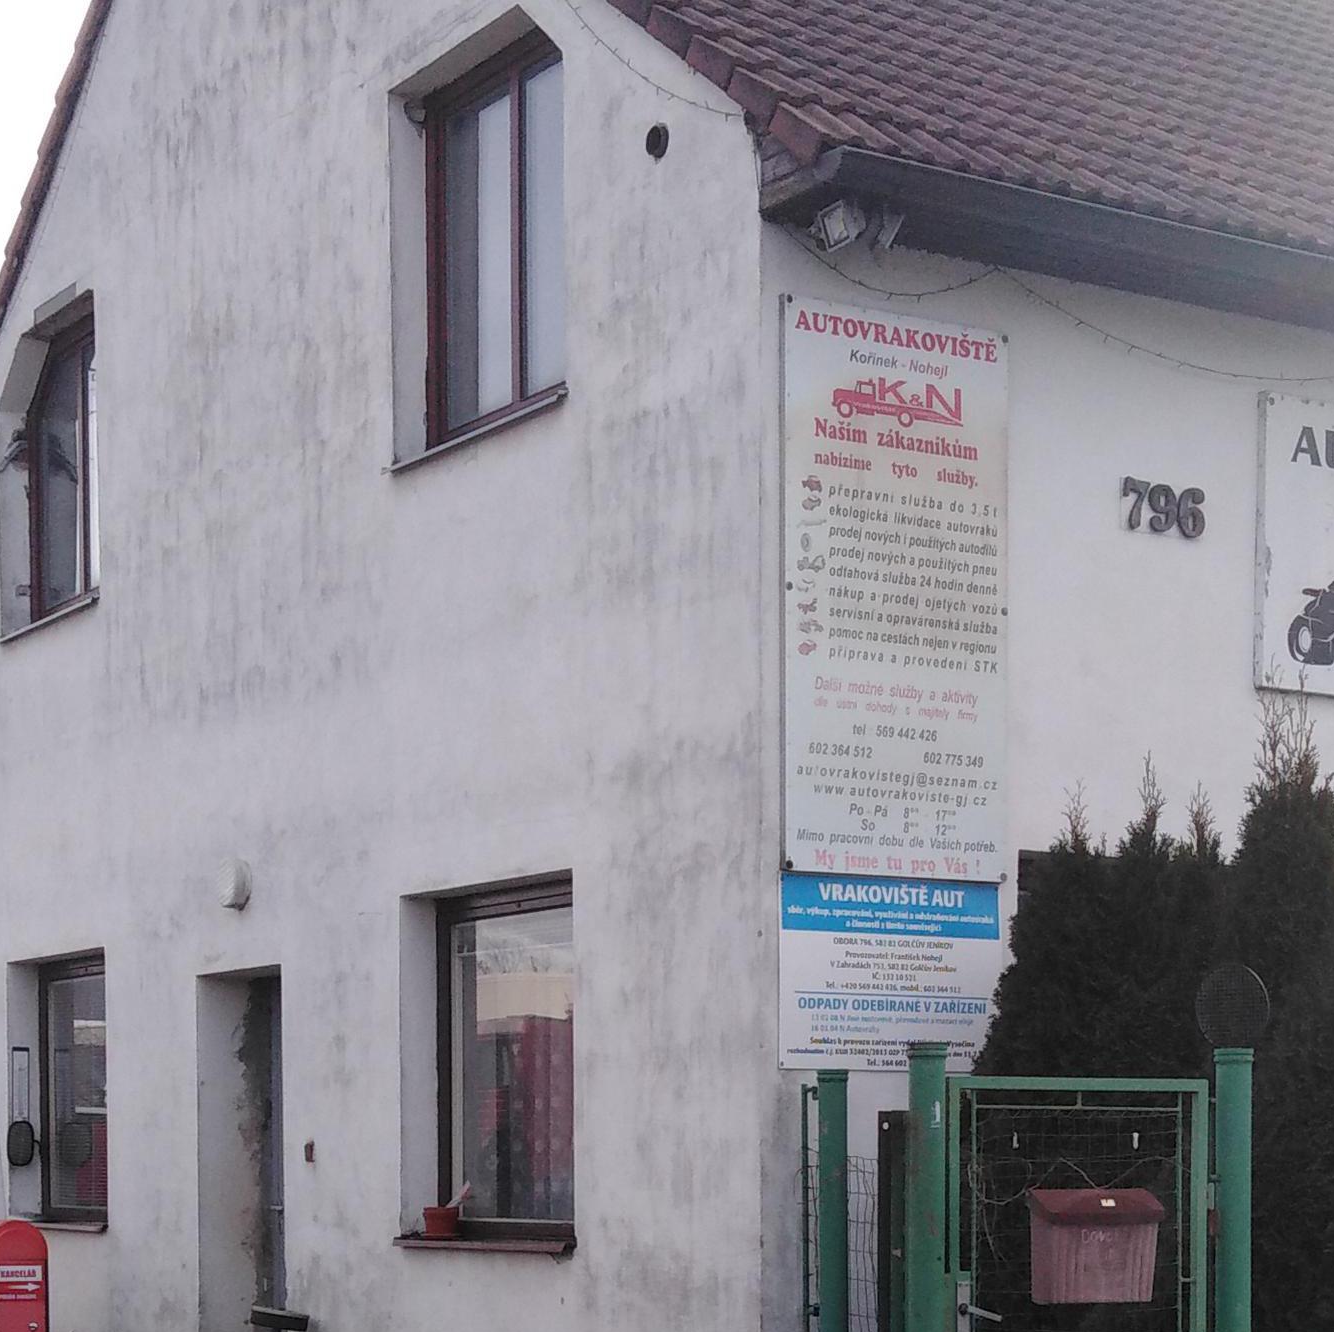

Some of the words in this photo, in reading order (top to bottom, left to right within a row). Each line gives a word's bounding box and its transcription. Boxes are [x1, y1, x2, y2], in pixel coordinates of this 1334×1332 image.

[795, 310, 998, 363] AUTOVRAKOVIŠTĚ
[909, 360, 948, 379] Nohejl
[892, 461, 917, 479] tyto
[901, 494, 943, 510] služba
[950, 499, 964, 513] do
[1123, 476, 1205, 538] 796
[894, 512, 941, 529] likvidace
[829, 526, 862, 542] prodej
[865, 530, 900, 547] nových
[909, 536, 956, 555] použitých
[829, 545, 865, 562] prodej
[868, 550, 906, 568] nových
[909, 555, 915, 566] a
[918, 557, 969, 577] použitých
[972, 565, 997, 577] pneu
[829, 566, 879, 581] odtahová
[882, 572, 916, 586] služba
[920, 575, 931, 587] 24
[935, 578, 964, 591] hodin
[829, 586, 864, 602] nákup
[870, 592, 876, 601] a
[882, 590, 919, 604] prodej
[925, 597, 966, 616] ojetých
[829, 607, 874, 621] servisní
[877, 611, 883, 622] a
[963, 621, 997, 635] služba
[829, 627, 863, 640] pomoc
[866, 630, 878, 642] na
[881, 631, 919, 646] cestách
[922, 638, 949, 651] nejen
[951, 641, 957, 650] v
[960, 641, 997, 656] regionu
[891, 653, 896, 663] a
[974, 660, 998, 673] STK
[890, 684, 923, 700] služby
[930, 690, 936, 700] a
[898, 727, 916, 740] 442
[919, 729, 937, 742] 426
[809, 742, 828, 755] 602
[831, 744, 850, 757] 364
[854, 745, 872, 759] 512
[923, 752, 942, 764] 602
[945, 753, 963, 766] 775
[965, 754, 984, 768] 349
[849, 803, 863, 816] Po
[874, 805, 888, 817] Pá
[861, 819, 875, 831] So
[797, 829, 824, 842] Mimo
[879, 835, 904, 847] dobu
[909, 837, 924, 848] dle
[930, 838, 961, 851] Vašich
[815, 849, 834, 870] My
[845, 851, 878, 870] jsme
[887, 854, 902, 870] tu
[911, 857, 936, 875] pro
[944, 857, 967, 874] Vás
[819, 883, 929, 906] VRAKOVIŠTĚ
[932, 889, 964, 908] AUT
[798, 996, 848, 1010] ODPADY
[924, 1001, 931, 1012] V
